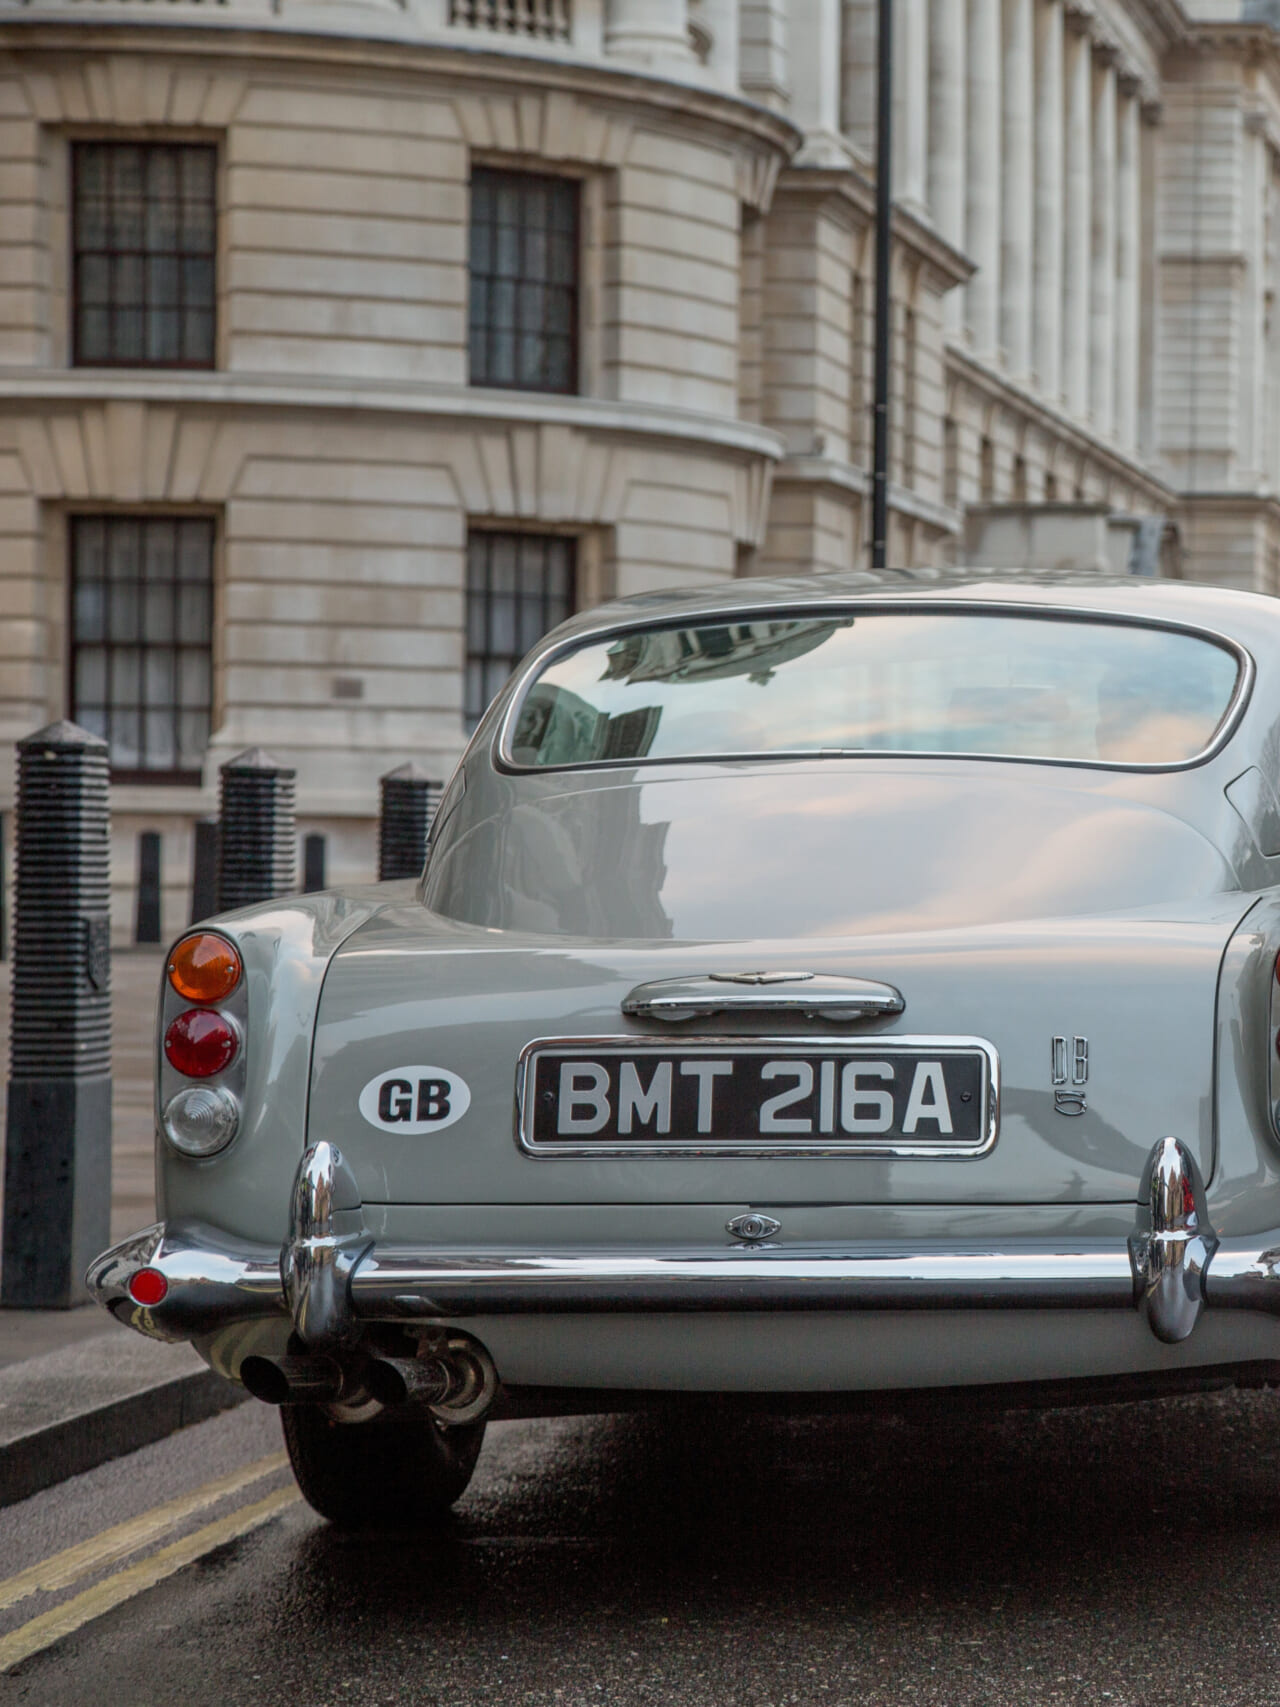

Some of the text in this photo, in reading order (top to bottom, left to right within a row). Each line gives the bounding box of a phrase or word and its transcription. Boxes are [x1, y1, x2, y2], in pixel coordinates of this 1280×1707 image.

[1051, 1035, 1089, 1085] DB
[378, 1077, 452, 1123] GB
[557, 1060, 955, 1134] BMT 216A
[1053, 1089, 1088, 1117] 5
